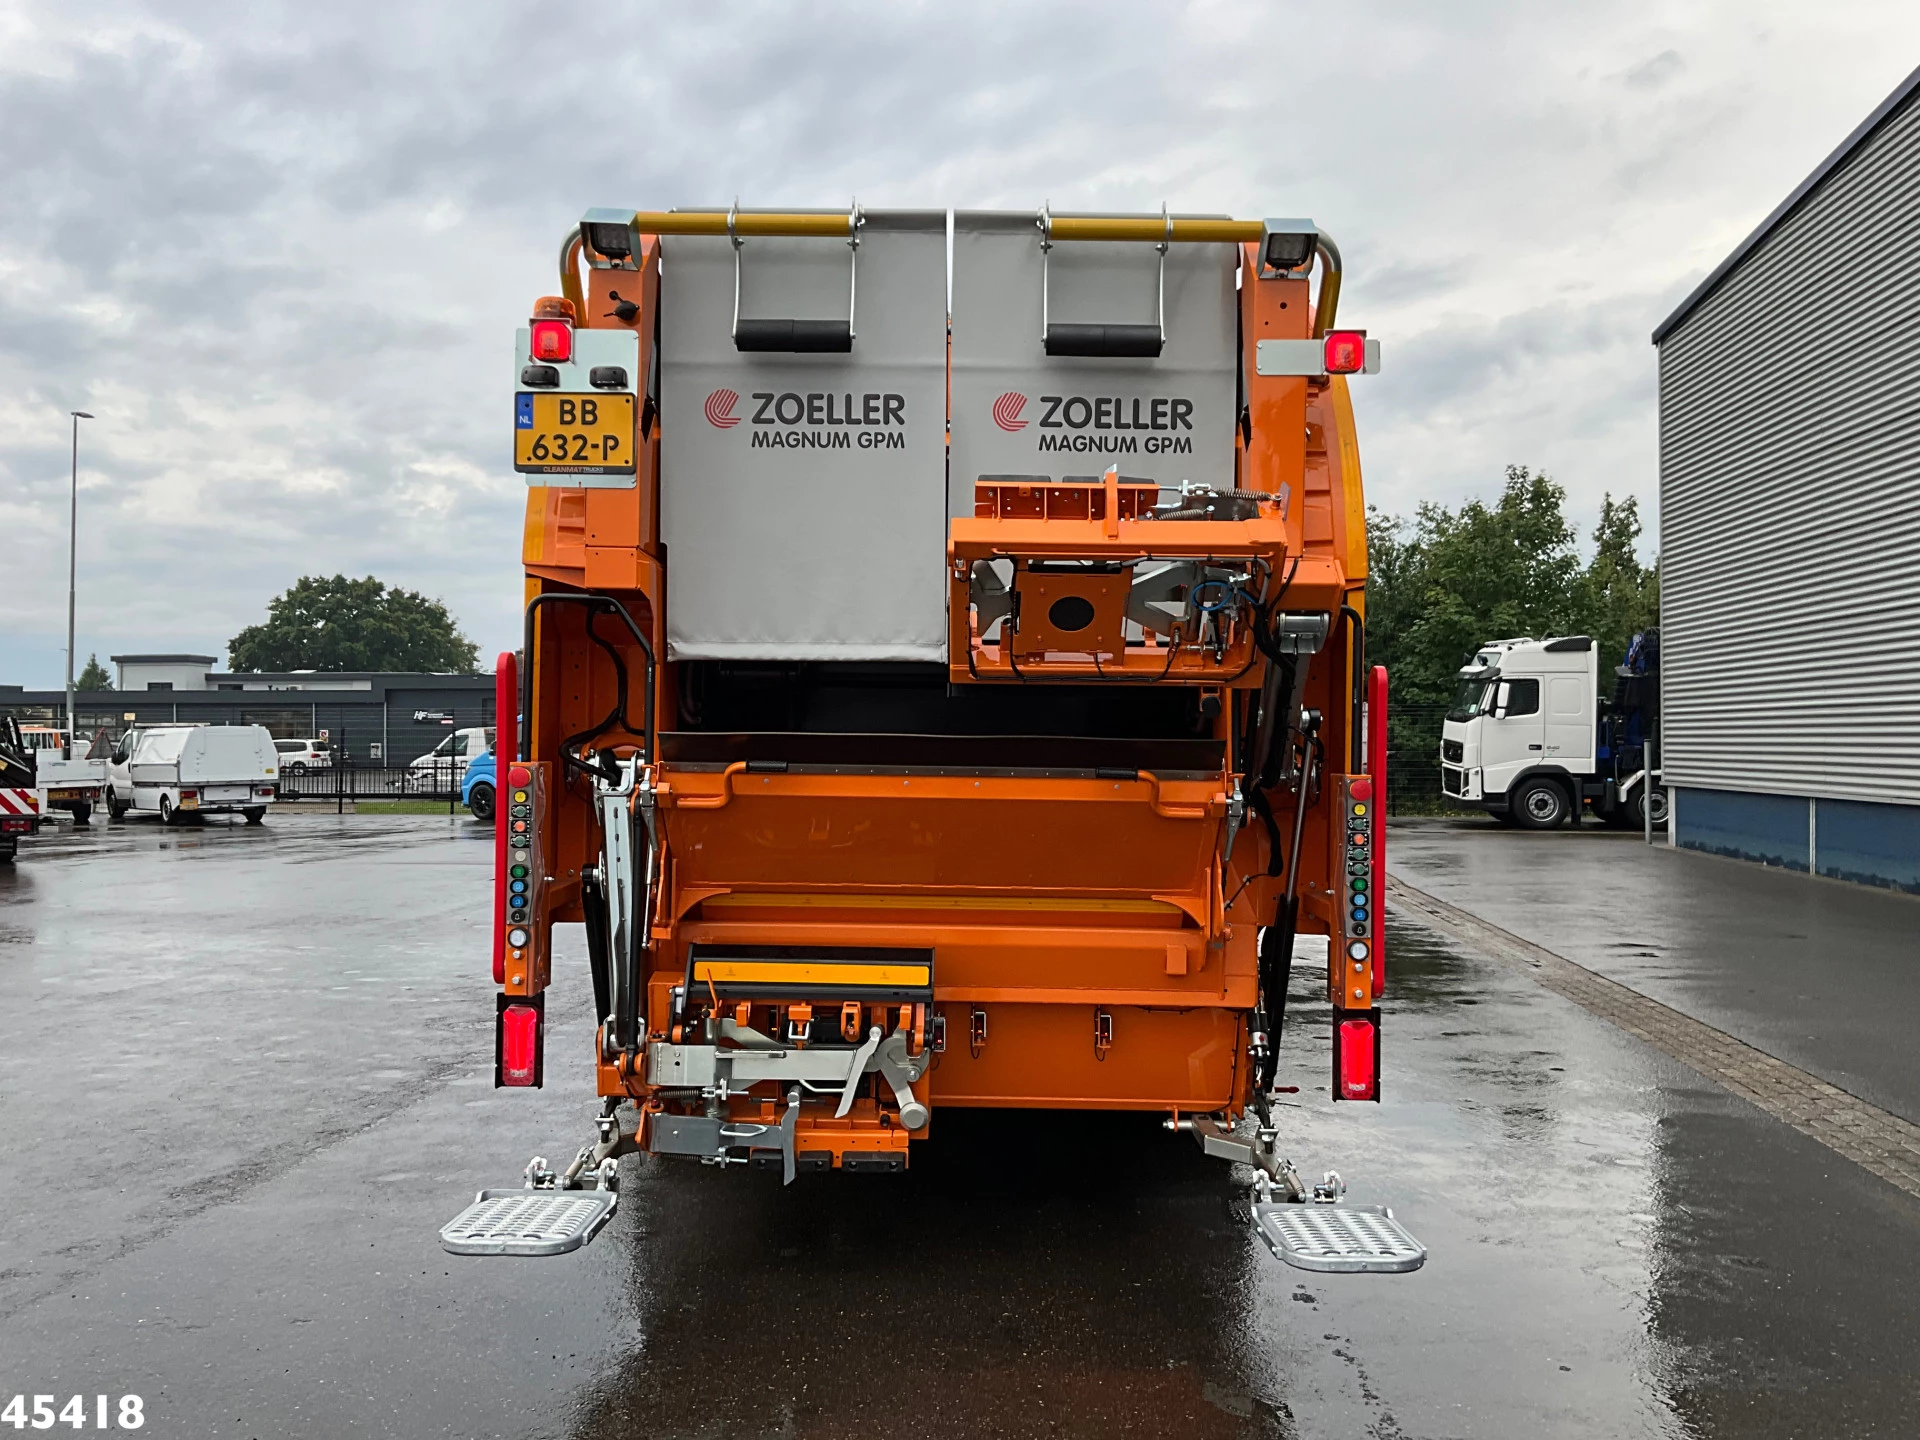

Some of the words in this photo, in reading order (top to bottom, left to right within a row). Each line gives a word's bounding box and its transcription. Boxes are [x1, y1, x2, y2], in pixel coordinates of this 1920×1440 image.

[519, 416, 532, 424] NL
[560, 399, 598, 425] BB
[751, 392, 905, 426] ZOELLER
[1039, 396, 1194, 431] ZOELLER
[532, 434, 620, 460] 632-P
[751, 430, 851, 448] MAGNUM
[857, 431, 905, 449] GPM
[1038, 434, 1138, 453] MAGNUM
[1144, 436, 1193, 454] GPM
[413, 711, 428, 720] HF
